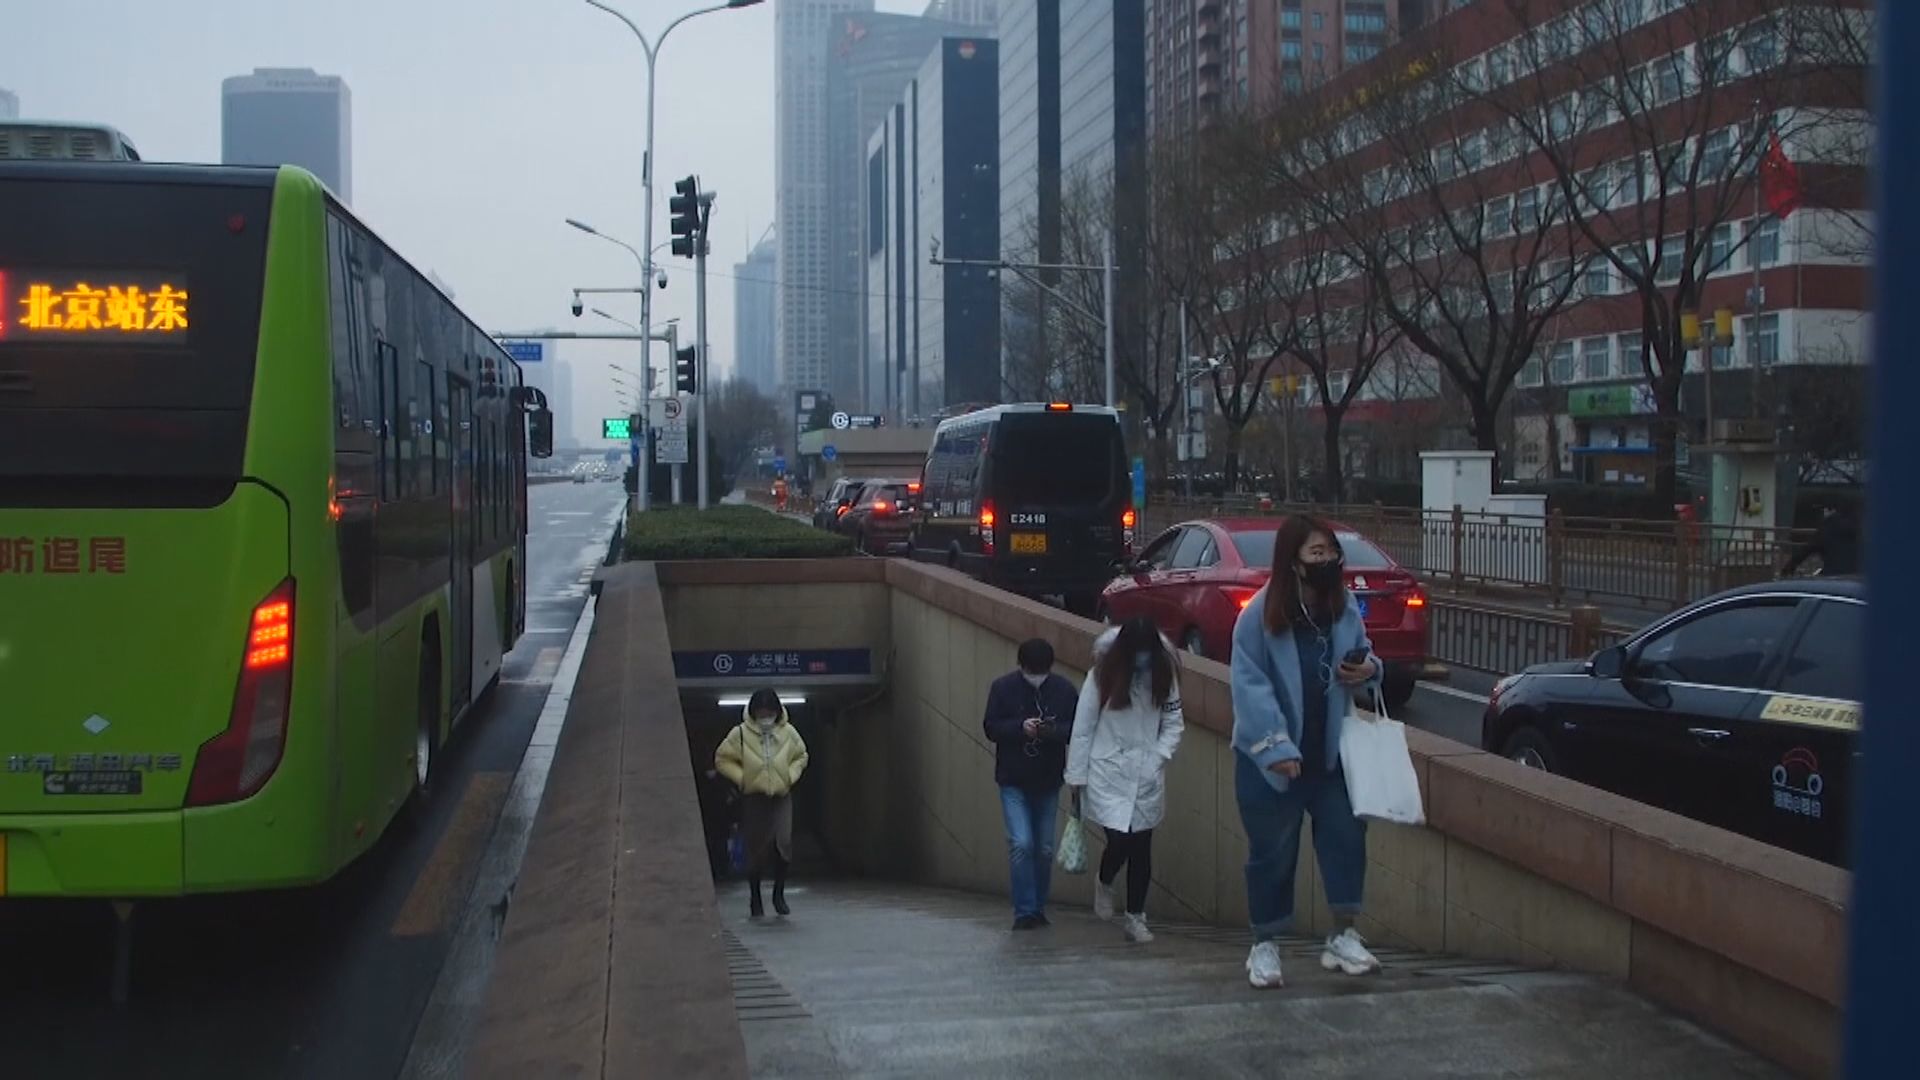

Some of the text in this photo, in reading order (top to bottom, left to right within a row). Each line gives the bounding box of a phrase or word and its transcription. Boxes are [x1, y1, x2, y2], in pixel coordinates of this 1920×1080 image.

[19, 284, 188, 330] 北京站东
[0, 536, 126, 574] 防追尾
